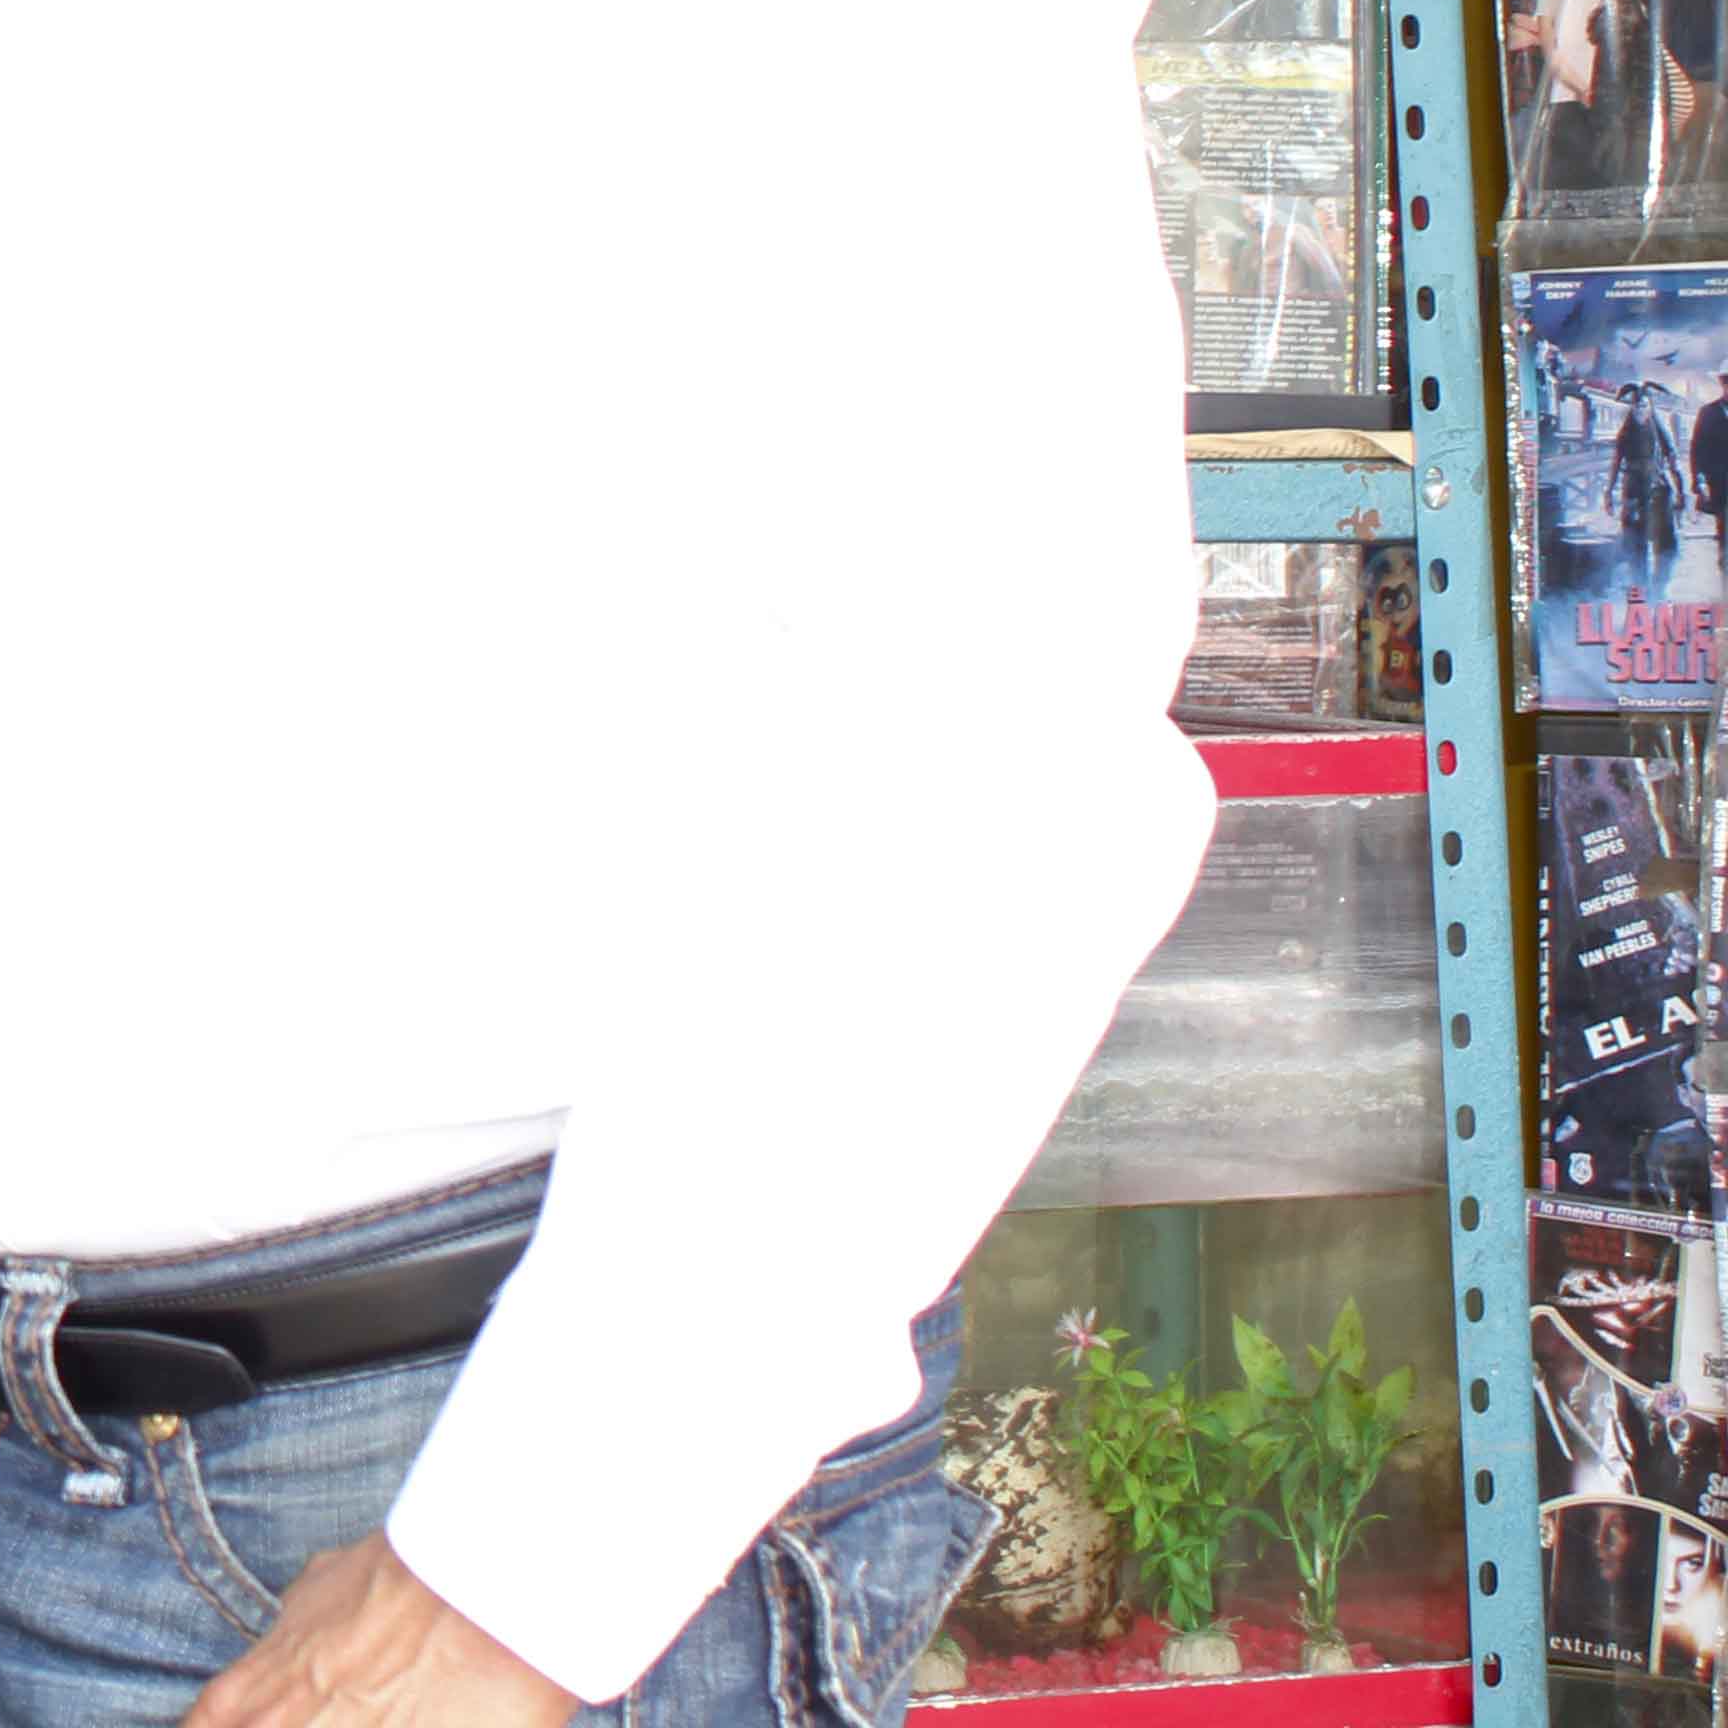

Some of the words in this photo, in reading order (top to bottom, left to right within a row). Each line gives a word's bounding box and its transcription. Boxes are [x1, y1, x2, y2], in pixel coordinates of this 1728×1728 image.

[1583, 839, 1627, 864] SNIPES
[1578, 948, 1609, 968] VAN
[1611, 932, 1658, 961] PEEBLES
[1583, 1014, 1646, 1061] EL
[1549, 1635, 1644, 1664] extraños
